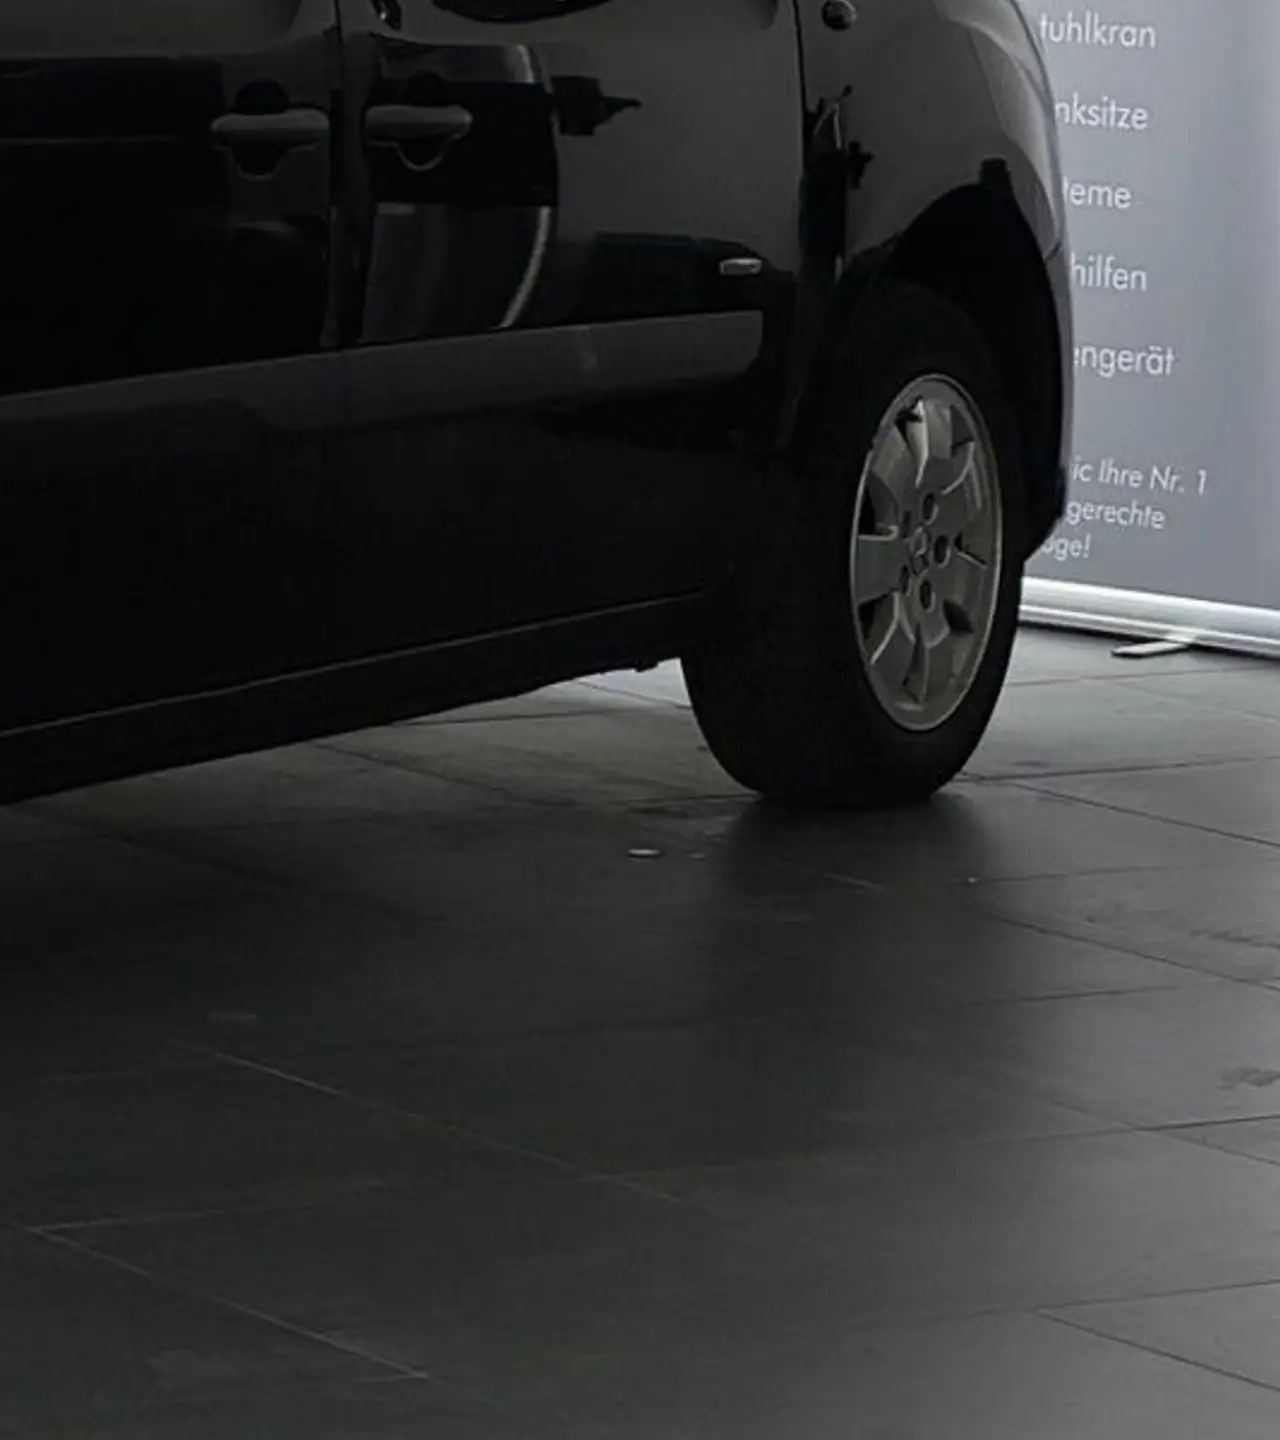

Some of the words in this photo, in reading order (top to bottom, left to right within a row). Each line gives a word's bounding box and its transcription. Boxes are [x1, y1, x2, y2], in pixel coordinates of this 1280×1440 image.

[1098, 459, 1143, 489] Ihre
[1149, 464, 1186, 494] Nr.
[1197, 468, 1209, 496] 1
